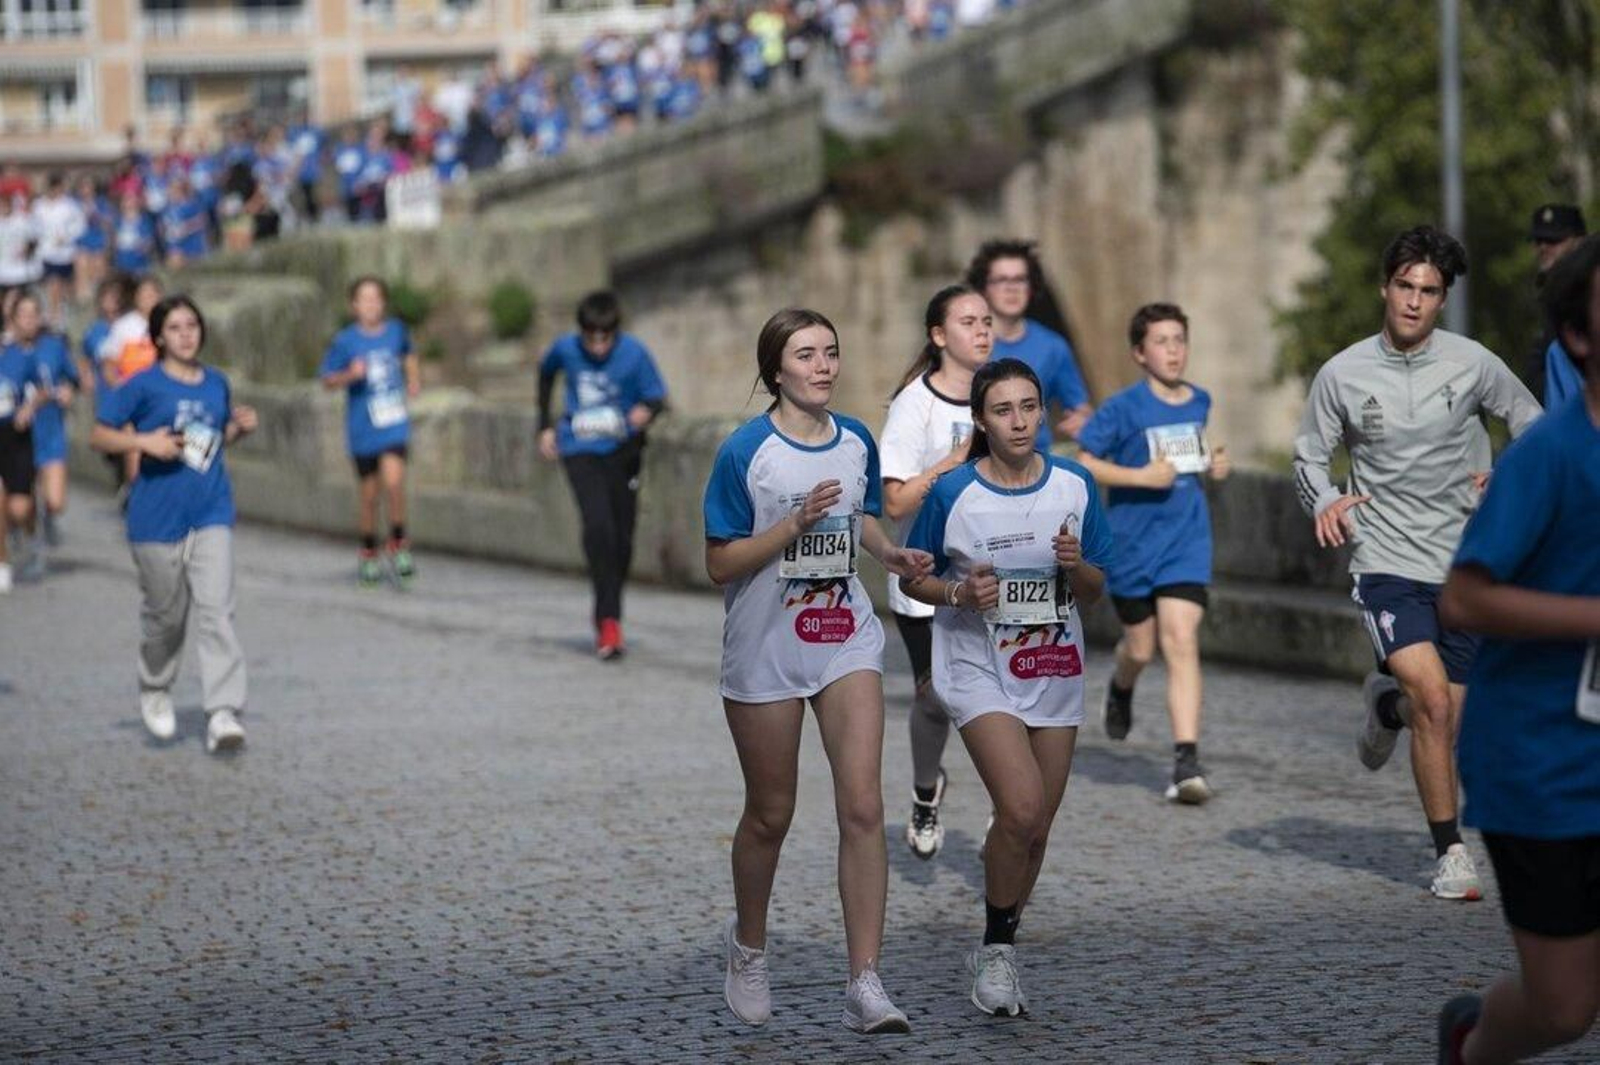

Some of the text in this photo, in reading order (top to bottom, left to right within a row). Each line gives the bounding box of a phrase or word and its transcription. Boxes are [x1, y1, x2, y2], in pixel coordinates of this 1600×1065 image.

[801, 533, 847, 556] 8034
[1007, 581, 1049, 603] 8122
[802, 617, 820, 633] 30
[1017, 656, 1035, 671] 30
